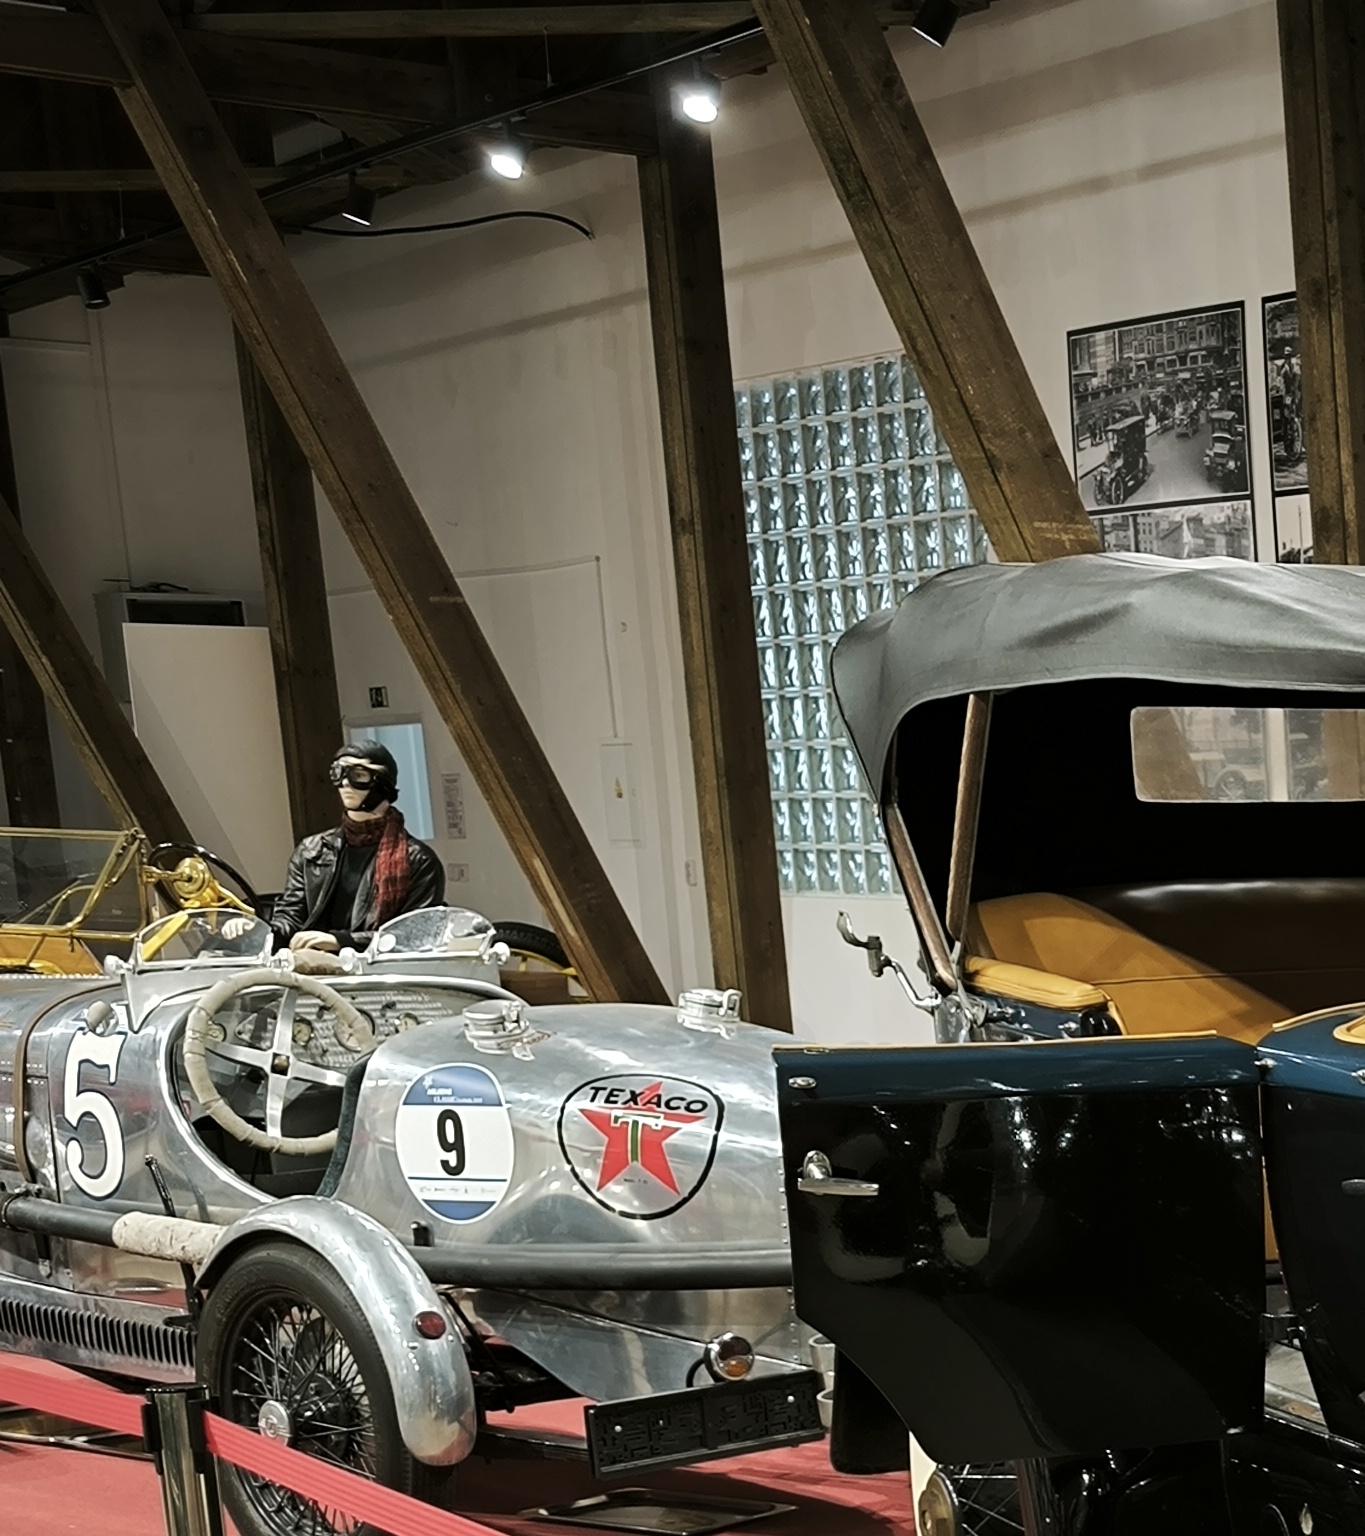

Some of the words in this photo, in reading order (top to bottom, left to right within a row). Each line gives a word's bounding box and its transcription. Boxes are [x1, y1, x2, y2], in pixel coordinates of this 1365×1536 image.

[63, 1026, 128, 1201] 5
[589, 1086, 709, 1114] TEXACO
[437, 1109, 466, 1177] 9
